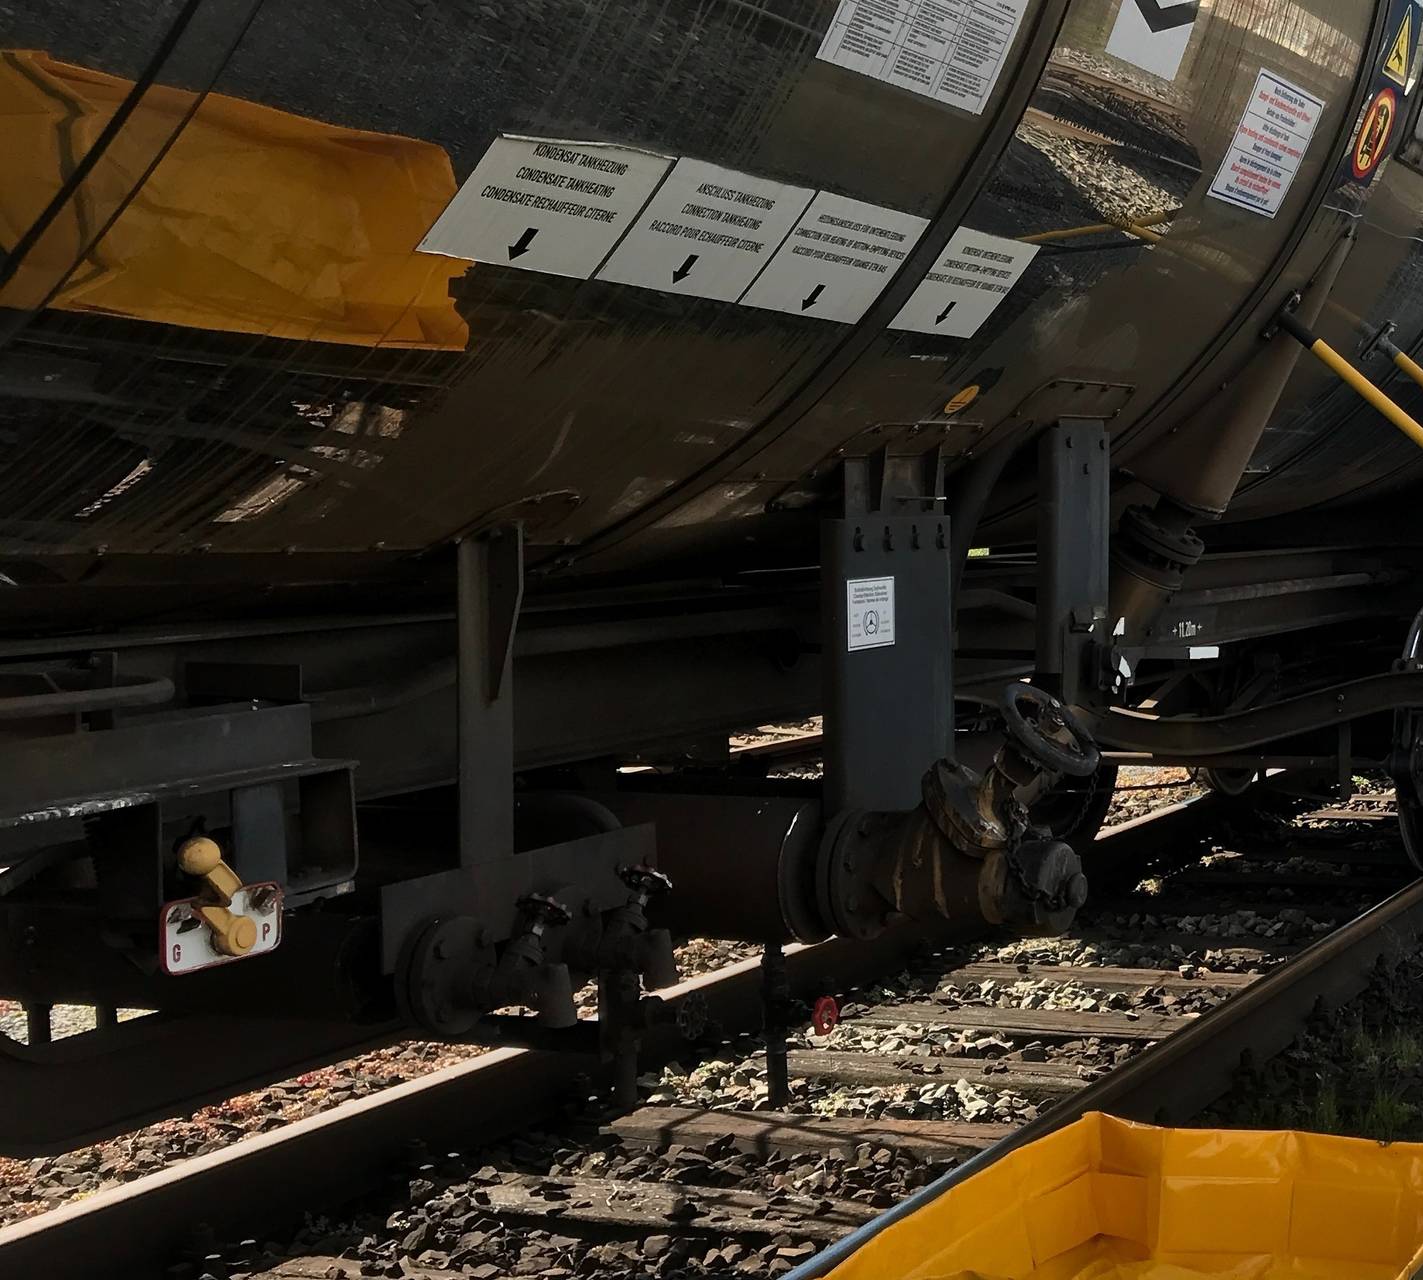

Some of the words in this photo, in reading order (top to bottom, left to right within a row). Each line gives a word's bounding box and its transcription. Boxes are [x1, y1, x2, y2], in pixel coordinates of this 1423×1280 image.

[533, 144, 580, 165] KONDENSAT
[577, 155, 628, 176] TANKHEIZUNG
[516, 166, 568, 188] CONDENSATE
[564, 178, 615, 198] TANKHEATING
[481, 186, 535, 207] CONDENSATE
[531, 196, 586, 218] RECHAUFFEUR
[584, 208, 617, 224] CITERNE
[696, 184, 736, 200] ANSCHLUSS
[734, 192, 776, 210] TANKHEIZUNG
[681, 204, 725, 220] CONNECTION
[721, 212, 762, 230] TANKHEATING
[649, 220, 683, 235] RACCORD
[680, 226, 700, 239] POUR
[737, 238, 764, 253] CITERNE
[262, 922, 270, 942] P
[172, 944, 181, 962] G
